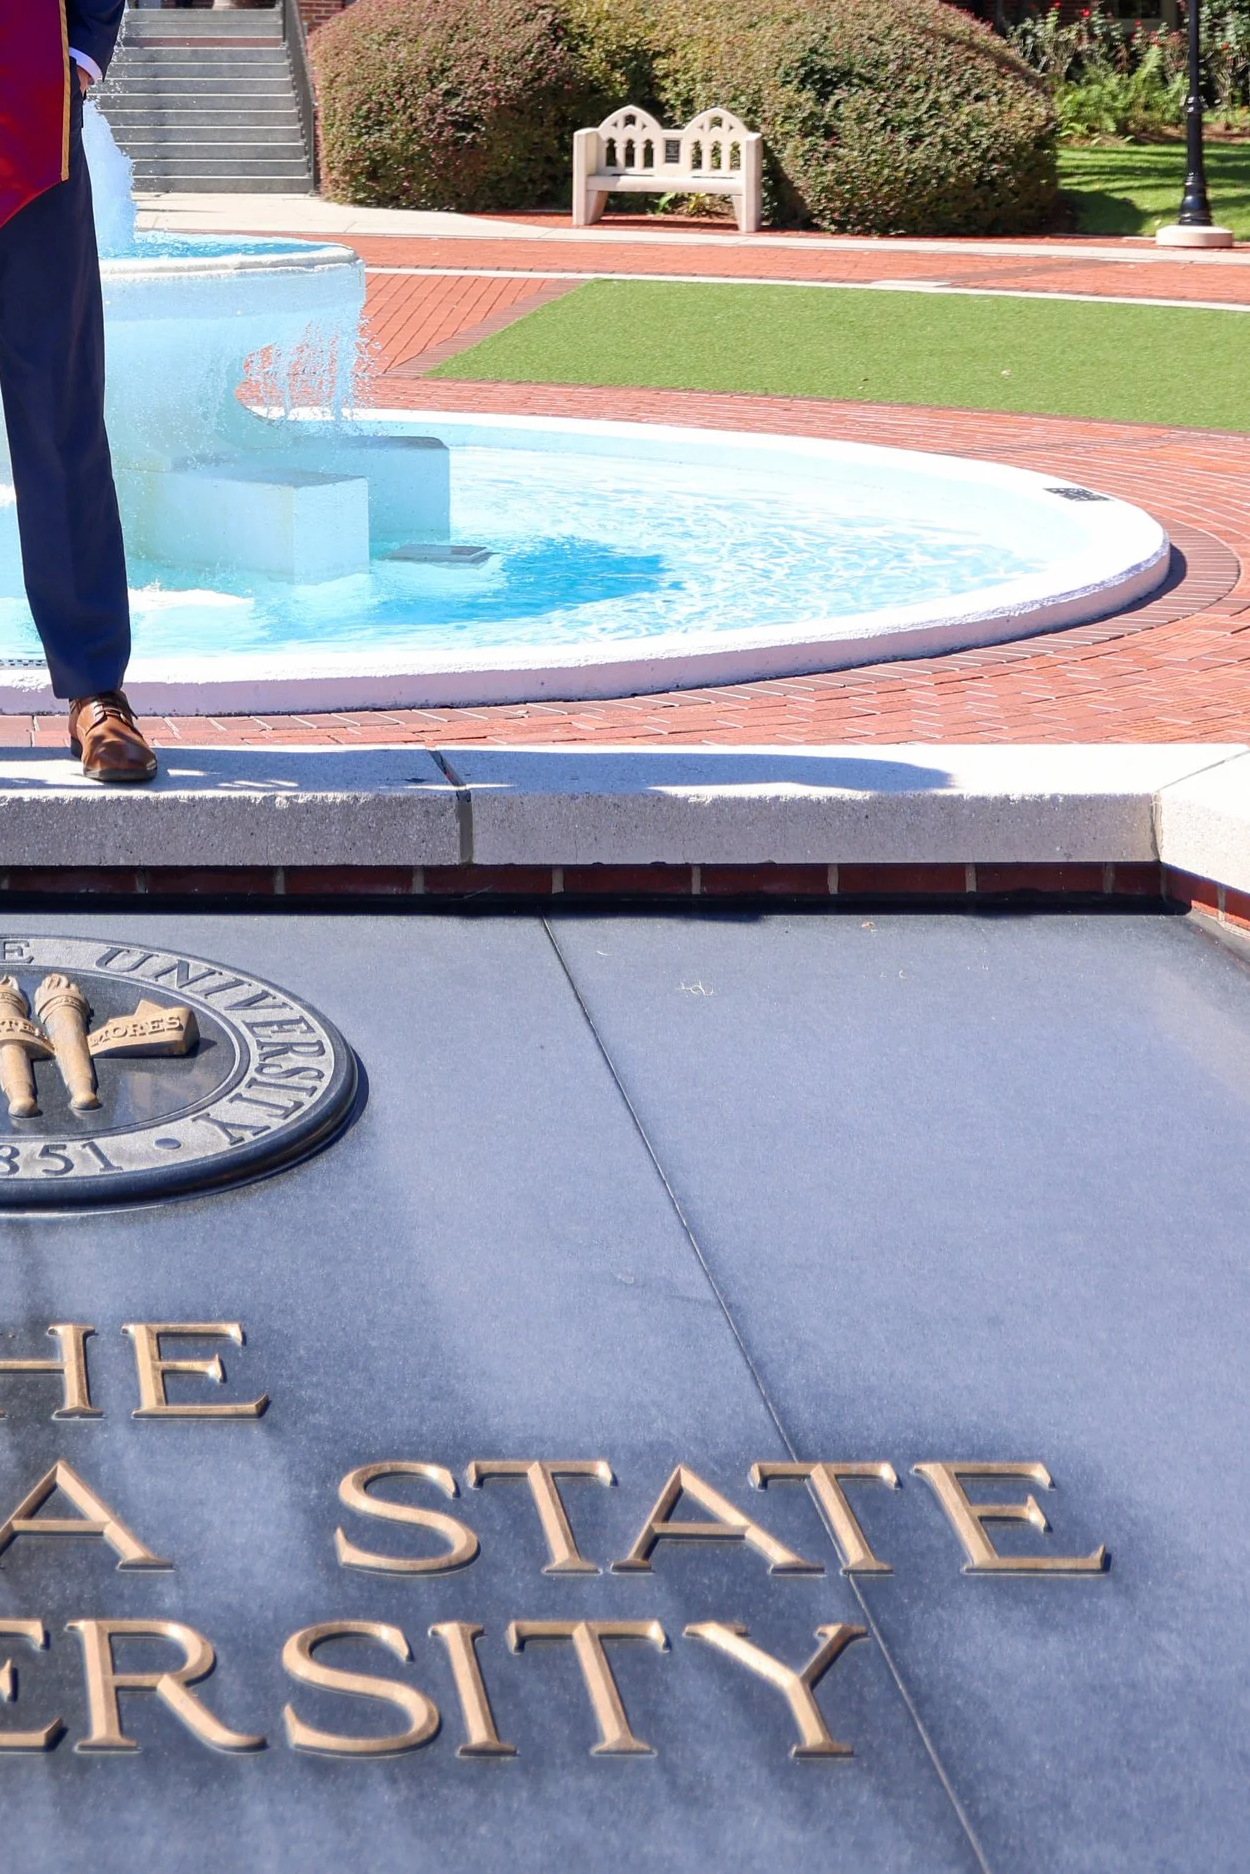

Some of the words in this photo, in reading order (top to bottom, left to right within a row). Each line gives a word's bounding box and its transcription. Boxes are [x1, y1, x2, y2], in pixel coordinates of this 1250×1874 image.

[90, 1016, 184, 1047] MORES
[95, 946, 325, 1146] UNIVERSITY
[334, 1459, 1111, 1576] STATE
